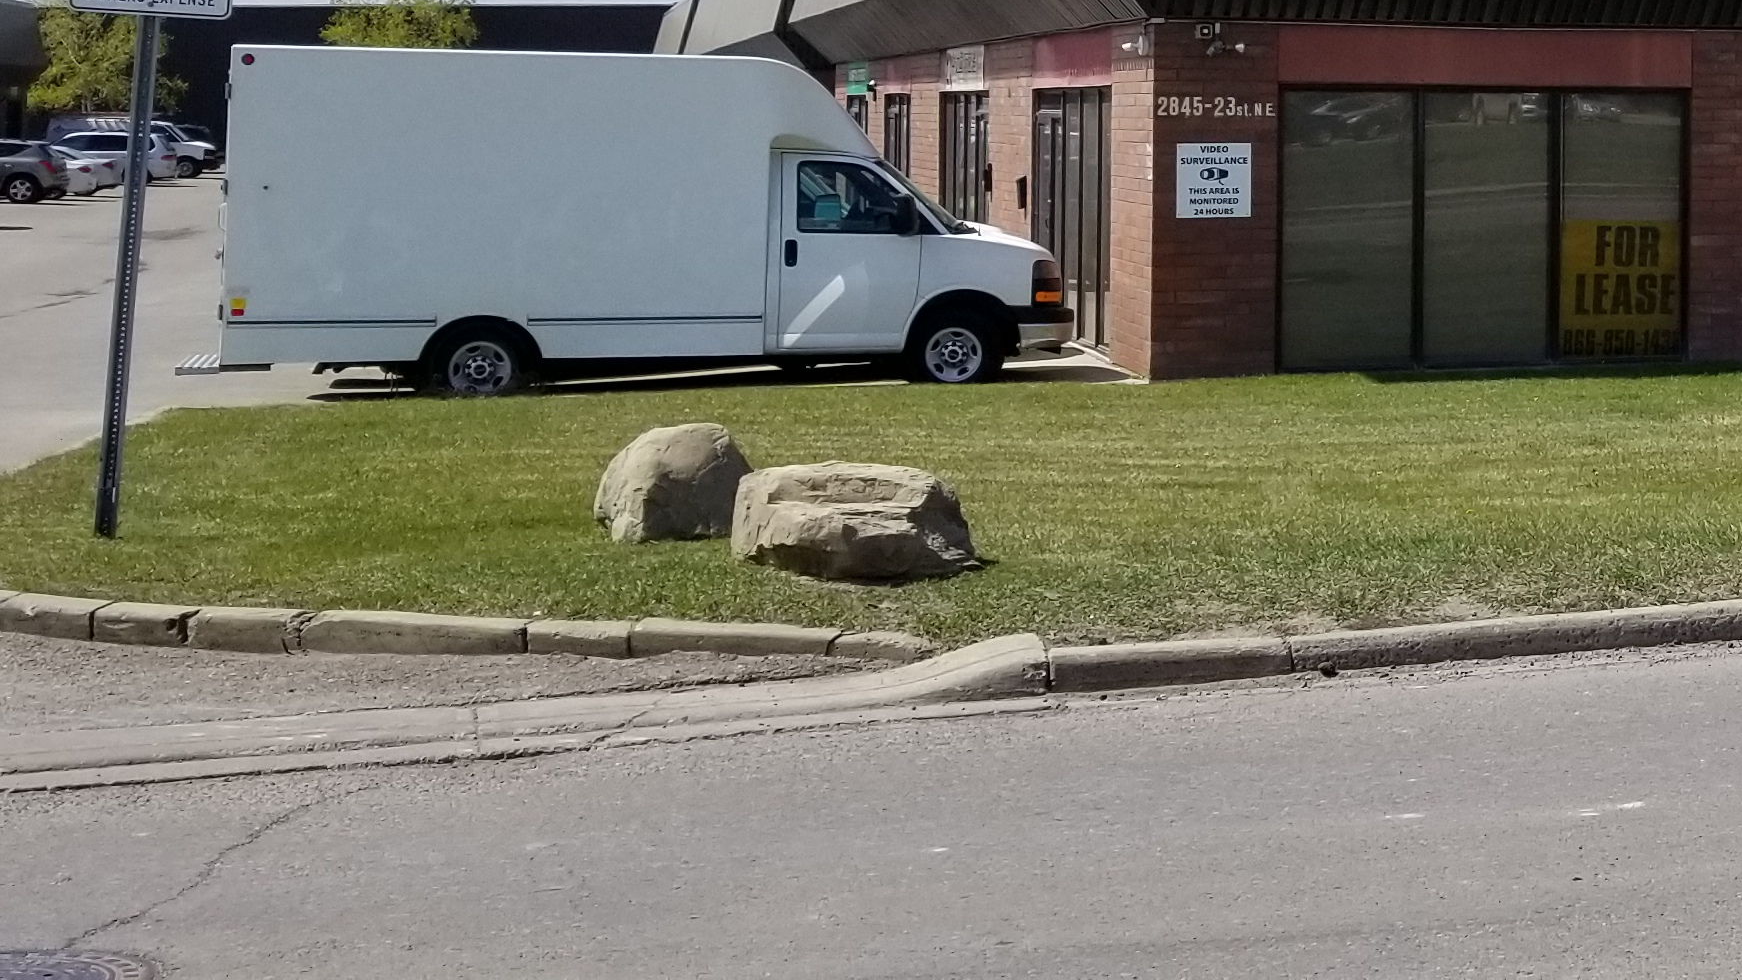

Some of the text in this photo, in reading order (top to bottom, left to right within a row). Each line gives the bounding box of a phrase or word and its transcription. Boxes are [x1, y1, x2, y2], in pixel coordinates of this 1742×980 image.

[1199, 145, 1229, 154] VIDEO
[1180, 156, 1248, 165] SURVEILLANCE
[1188, 187, 1240, 195] THIS AREA IS
[1189, 197, 1239, 205] MONITORED
[1193, 207, 1235, 216] 24 HOURS
[1595, 226, 1660, 267] FOR
[1575, 273, 1676, 316] LEASE
